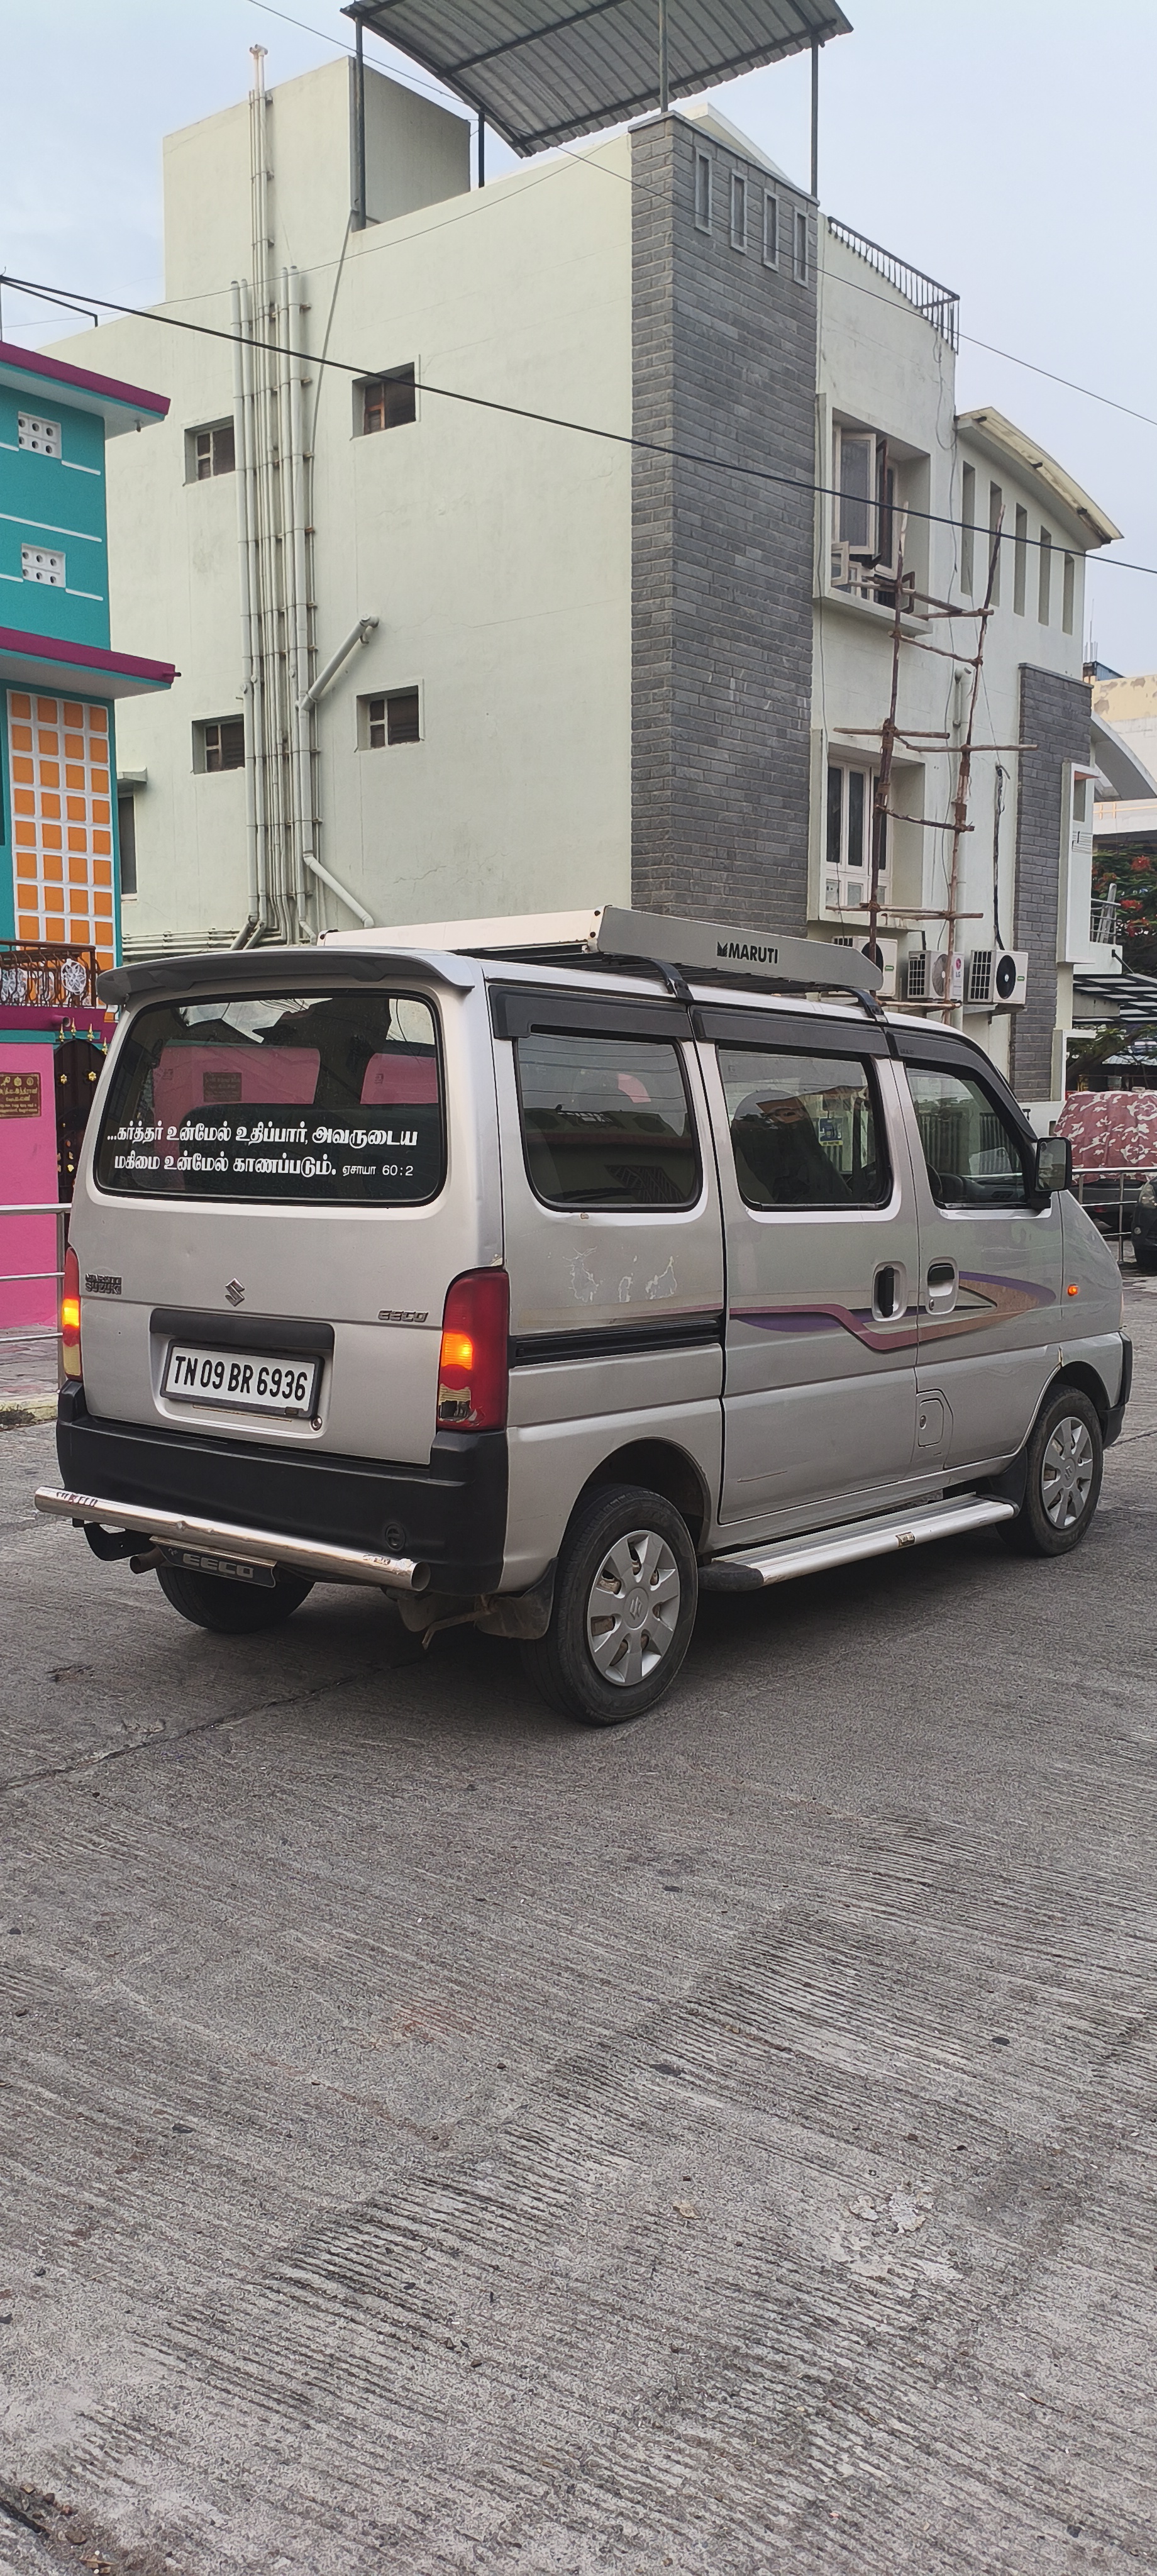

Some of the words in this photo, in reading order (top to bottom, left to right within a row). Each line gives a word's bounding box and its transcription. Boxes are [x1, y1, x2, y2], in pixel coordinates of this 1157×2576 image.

[729, 942, 778, 964] MARUTI
[166, 1120, 231, 1141] உன்மேல்
[235, 1121, 308, 1146] உதிப்பார்,
[312, 1126, 418, 1149] அவருடைய
[114, 1150, 160, 1169] மகிமை
[163, 1150, 229, 1172] உன்மேல்
[233, 1152, 336, 1178] காணப்படும்.
[342, 1165, 377, 1177] ஏசாயா
[382, 1165, 414, 1176] 60:2
[377, 1309, 429, 1323] EECO
[174, 1355, 198, 1386] TN
[200, 1359, 225, 1389] 09
[227, 1362, 253, 1394] BR
[257, 1367, 307, 1401] 6936
[183, 1553, 254, 1579] EECO
